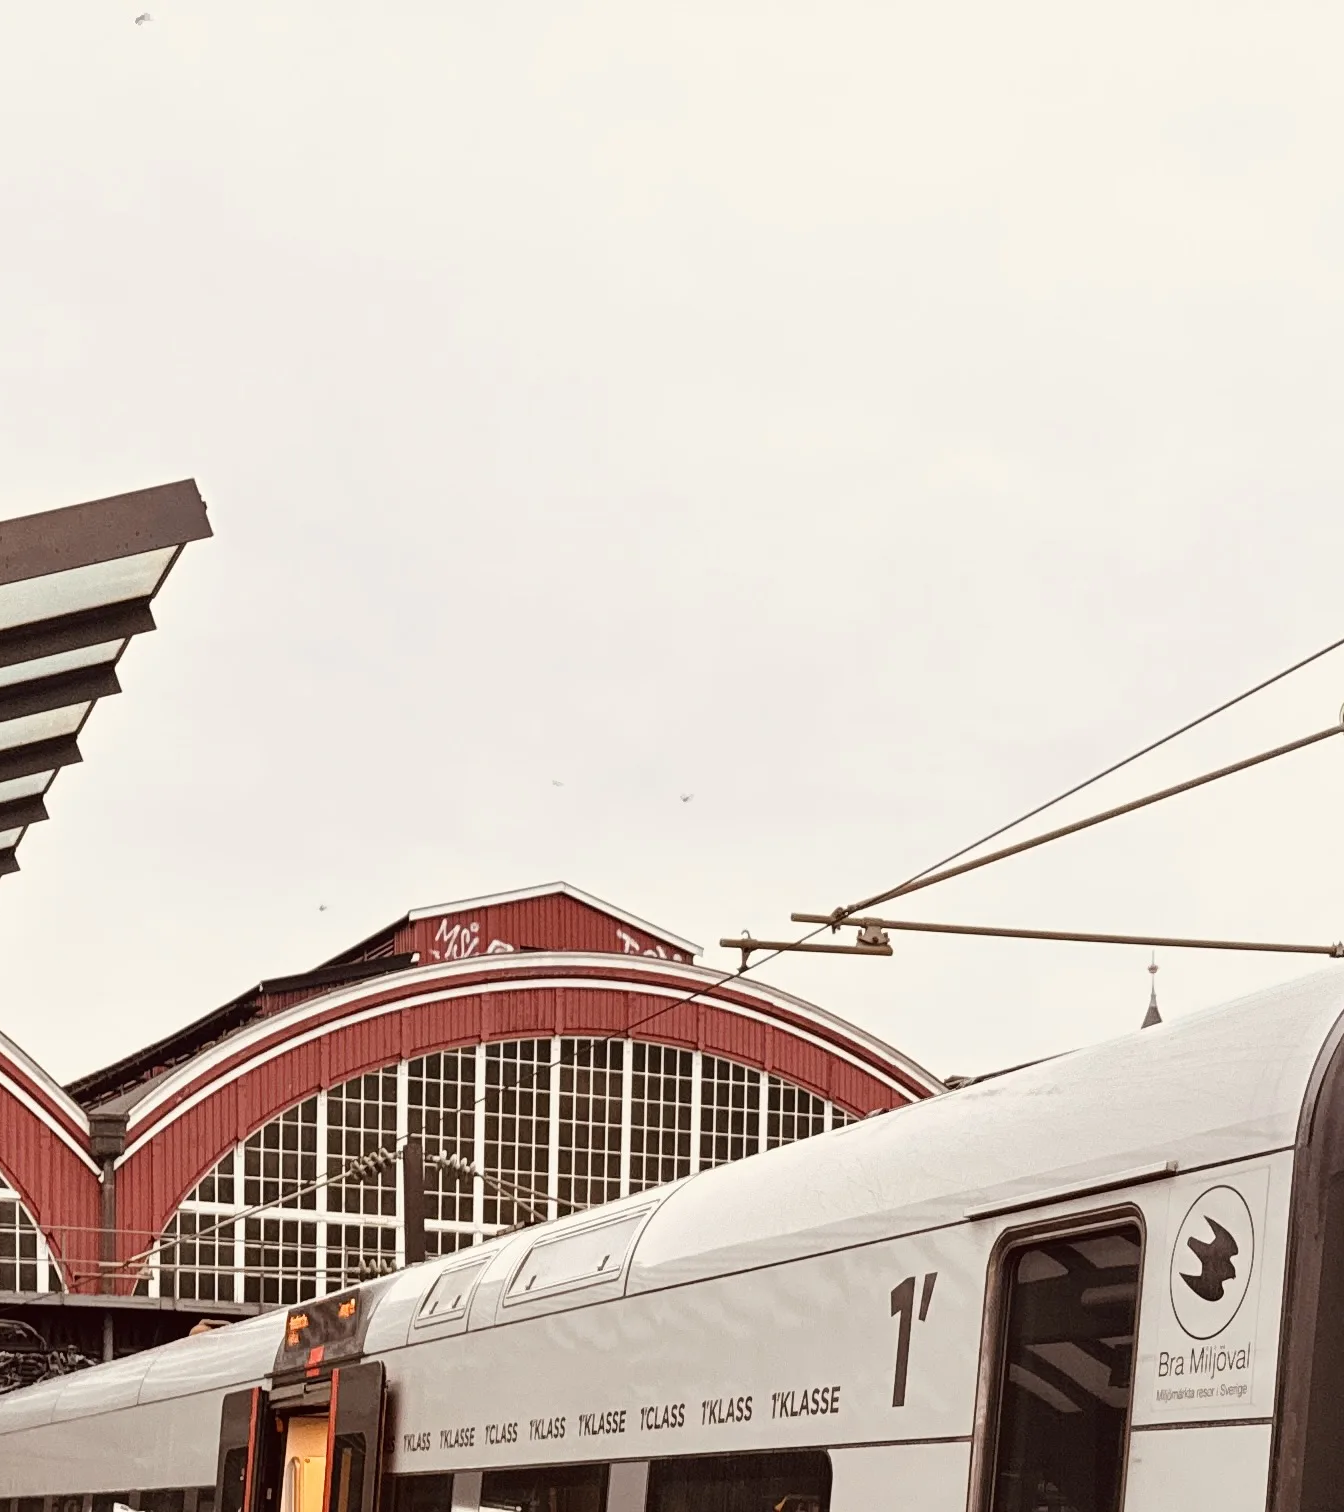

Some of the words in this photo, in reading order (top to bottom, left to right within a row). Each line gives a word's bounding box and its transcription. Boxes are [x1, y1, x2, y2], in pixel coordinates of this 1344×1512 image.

[1158, 1351, 1184, 1377] Bra
[1190, 1341, 1251, 1380] Miljöval
[1196, 1387, 1215, 1399] resor
[1220, 1383, 1248, 1399] Sverige
